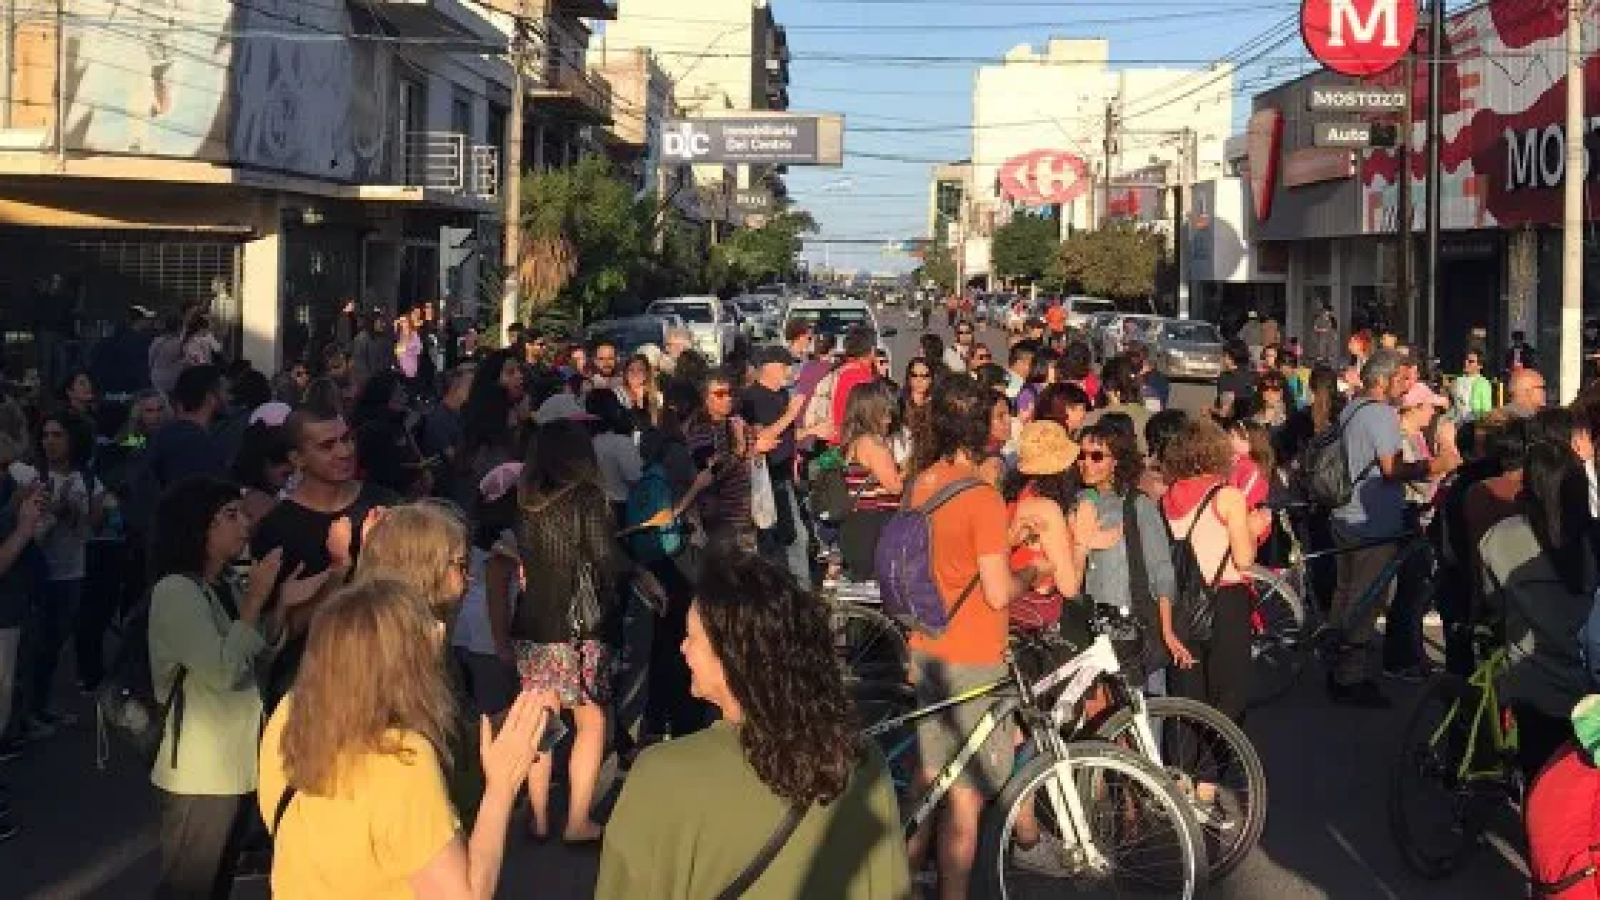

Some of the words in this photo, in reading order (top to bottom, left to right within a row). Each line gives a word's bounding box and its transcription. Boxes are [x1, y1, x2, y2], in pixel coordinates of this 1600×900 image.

[1327, 0, 1401, 47] M
[1327, 128, 1370, 141] Auto
[751, 138, 793, 152] Centro
